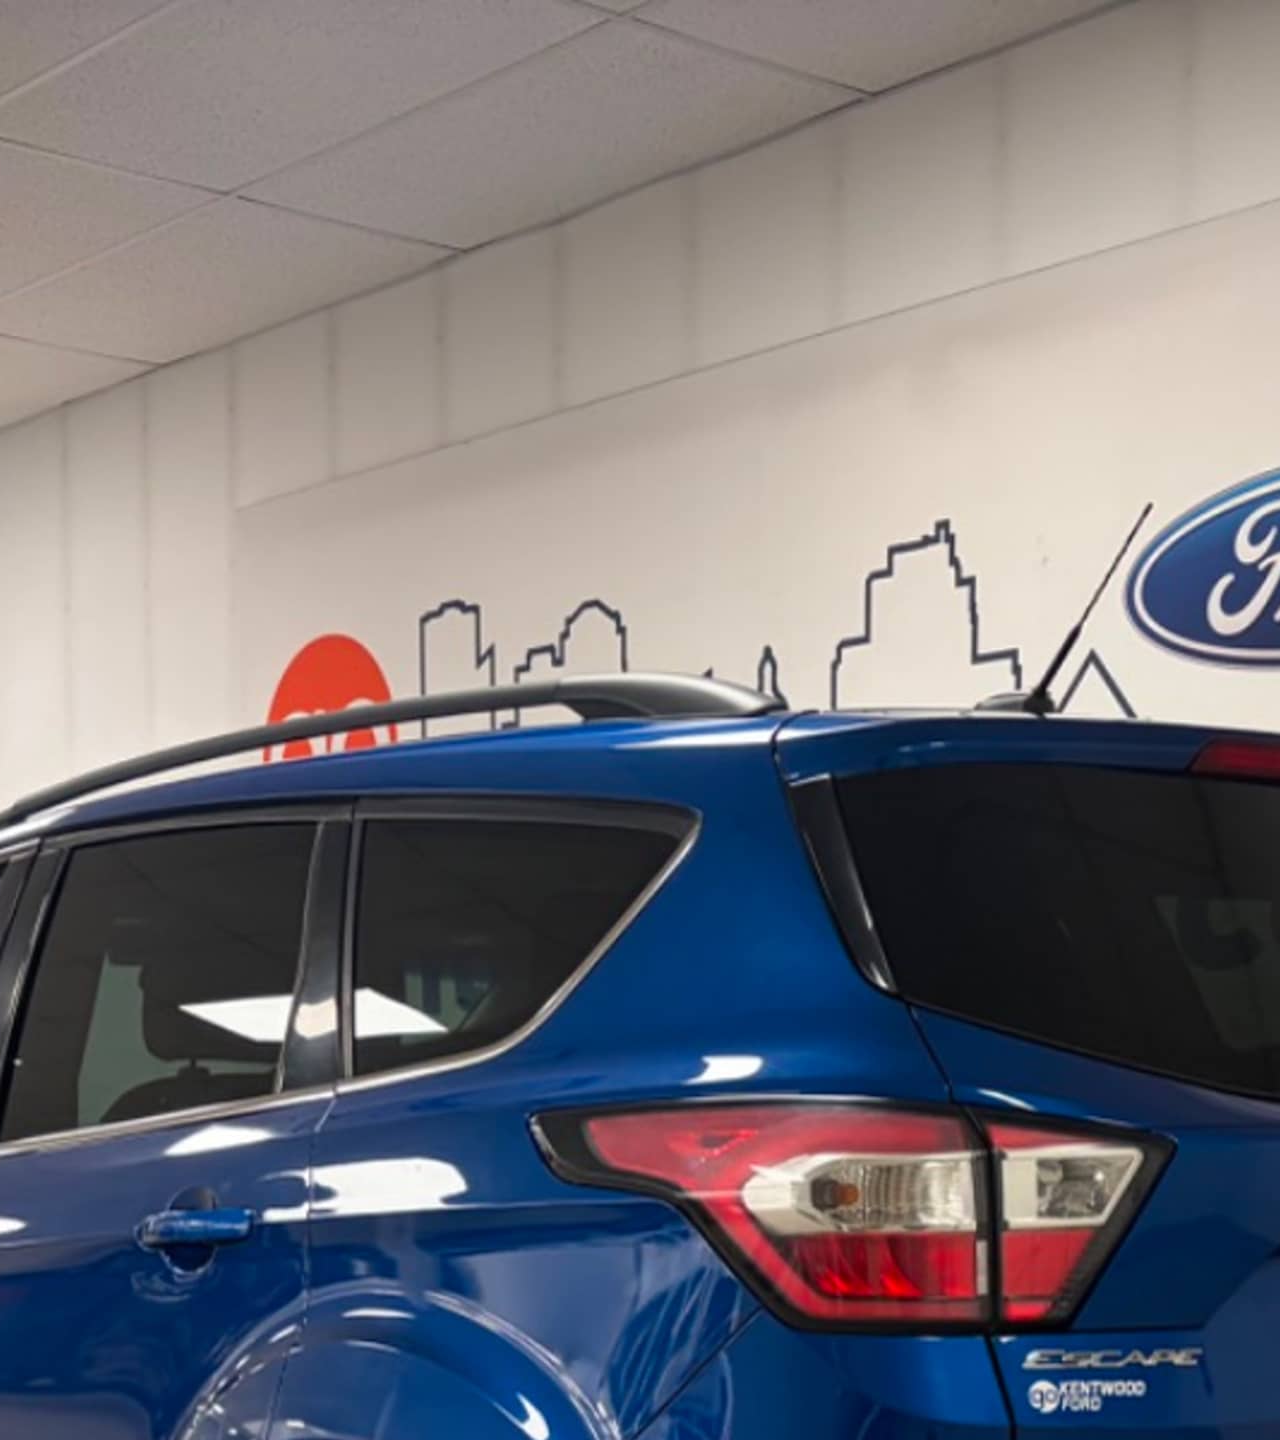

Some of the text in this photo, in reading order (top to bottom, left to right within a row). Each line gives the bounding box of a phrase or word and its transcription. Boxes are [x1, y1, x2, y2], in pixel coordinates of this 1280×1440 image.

[1022, 1347, 1203, 1370] ESCAPE
[1060, 1380, 1147, 1396] KENTWOOD
[1061, 1396, 1102, 1412] FORD
